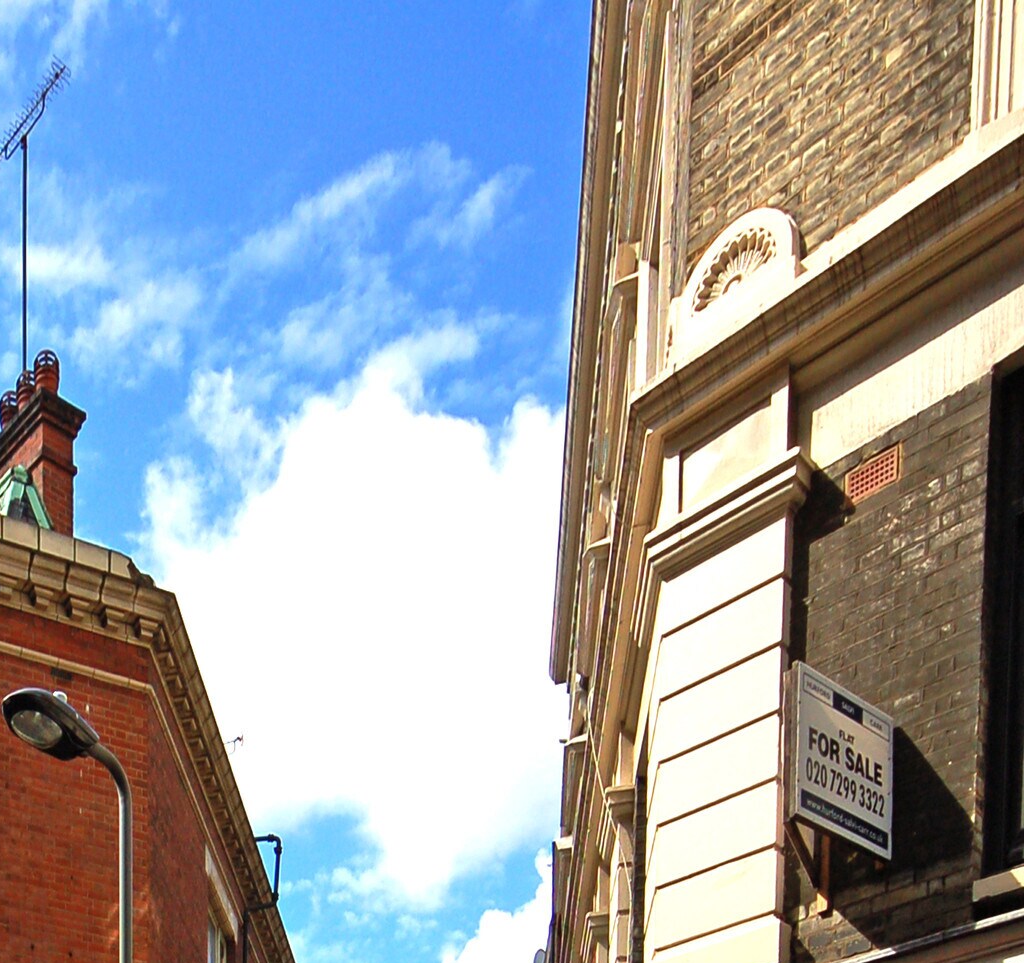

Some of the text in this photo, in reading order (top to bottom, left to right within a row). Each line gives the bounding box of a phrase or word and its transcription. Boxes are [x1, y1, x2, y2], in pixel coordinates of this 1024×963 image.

[808, 726, 882, 787] FOR SALE
[839, 729, 855, 745] FLAT
[806, 757, 885, 818] 020 7299 3322
